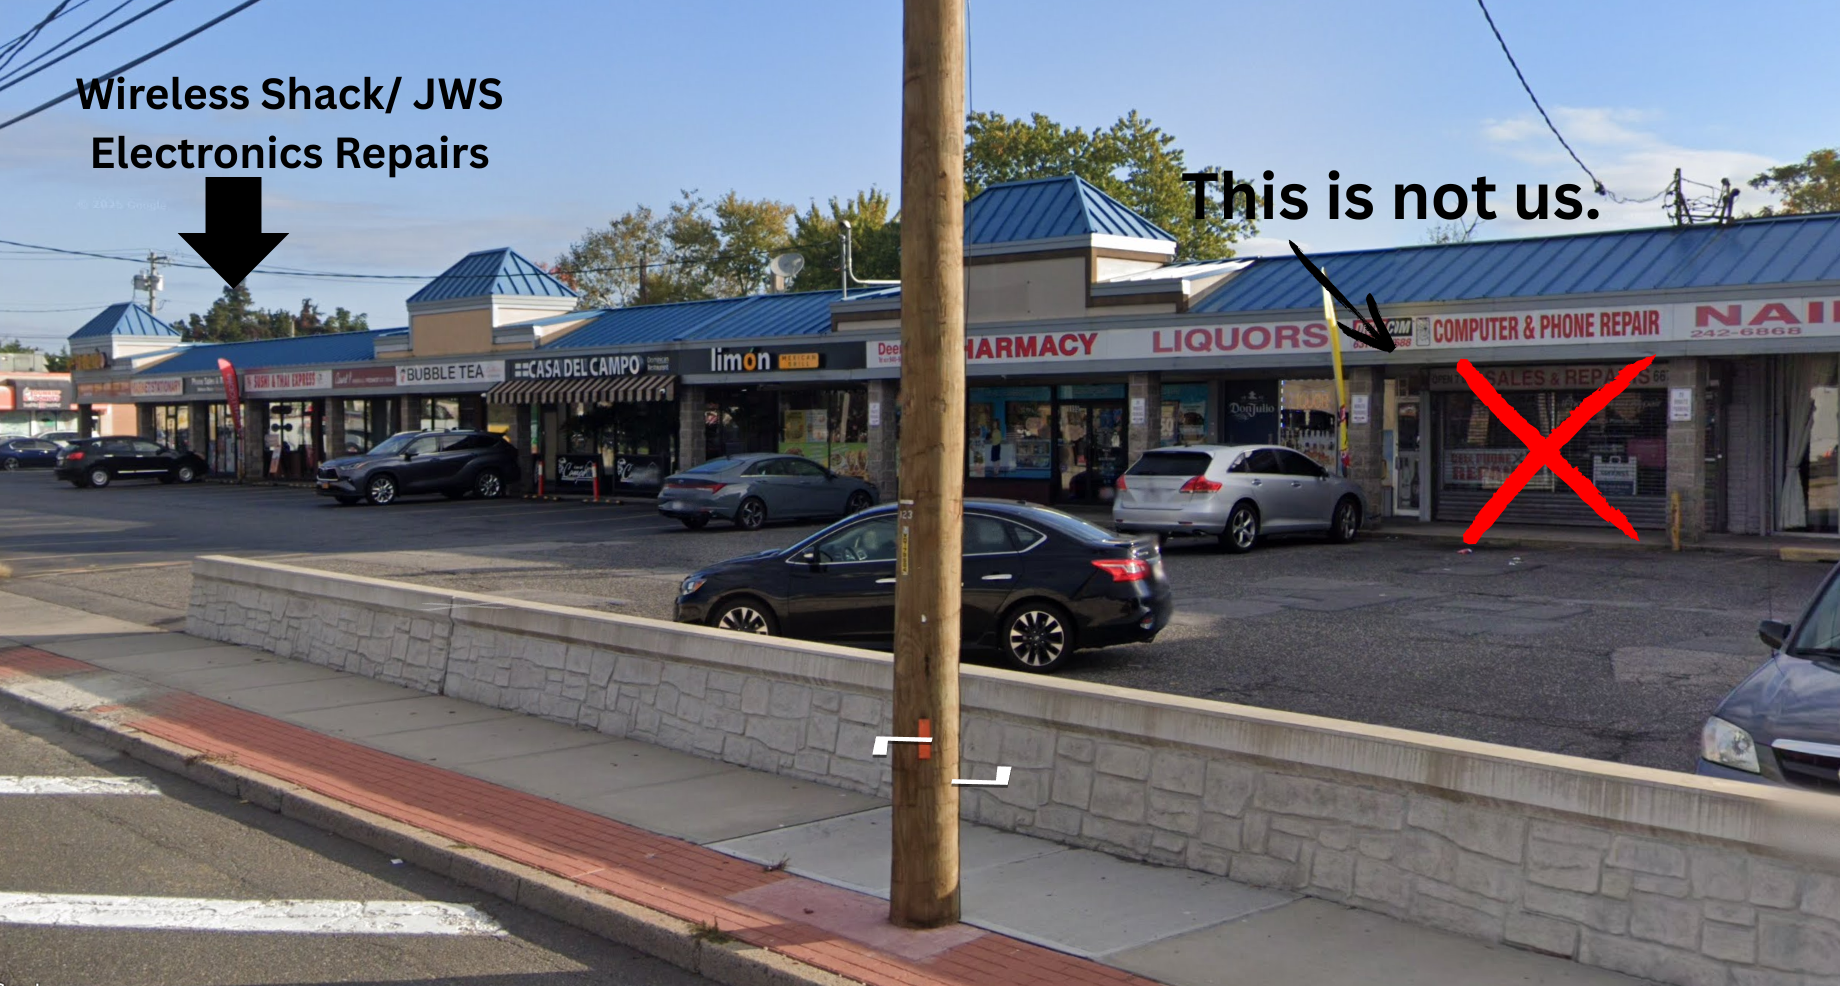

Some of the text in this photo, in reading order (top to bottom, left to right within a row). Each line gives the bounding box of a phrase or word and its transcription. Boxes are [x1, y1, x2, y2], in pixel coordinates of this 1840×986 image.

[1695, 301, 1840, 327] NAI
[1433, 310, 1660, 343] COMPUTER & PHONE REPAIR
[1690, 327, 1802, 338] 242-6868
[964, 332, 1098, 360] HARMACY
[1152, 323, 1329, 354] LIQUORS
[528, 355, 640, 378] CASA DEL CAMPO
[711, 347, 771, 371] limón
[253, 373, 270, 388] SUSHI
[271, 373, 277, 388] &
[276, 373, 290, 388] THAI
[292, 372, 316, 387] EXPRESS
[407, 365, 456, 382] BUBBLE
[459, 364, 484, 380] TEA
[1487, 368, 1546, 386] SALES
[1550, 371, 1560, 385] &
[1565, 367, 1650, 386] REPAS
